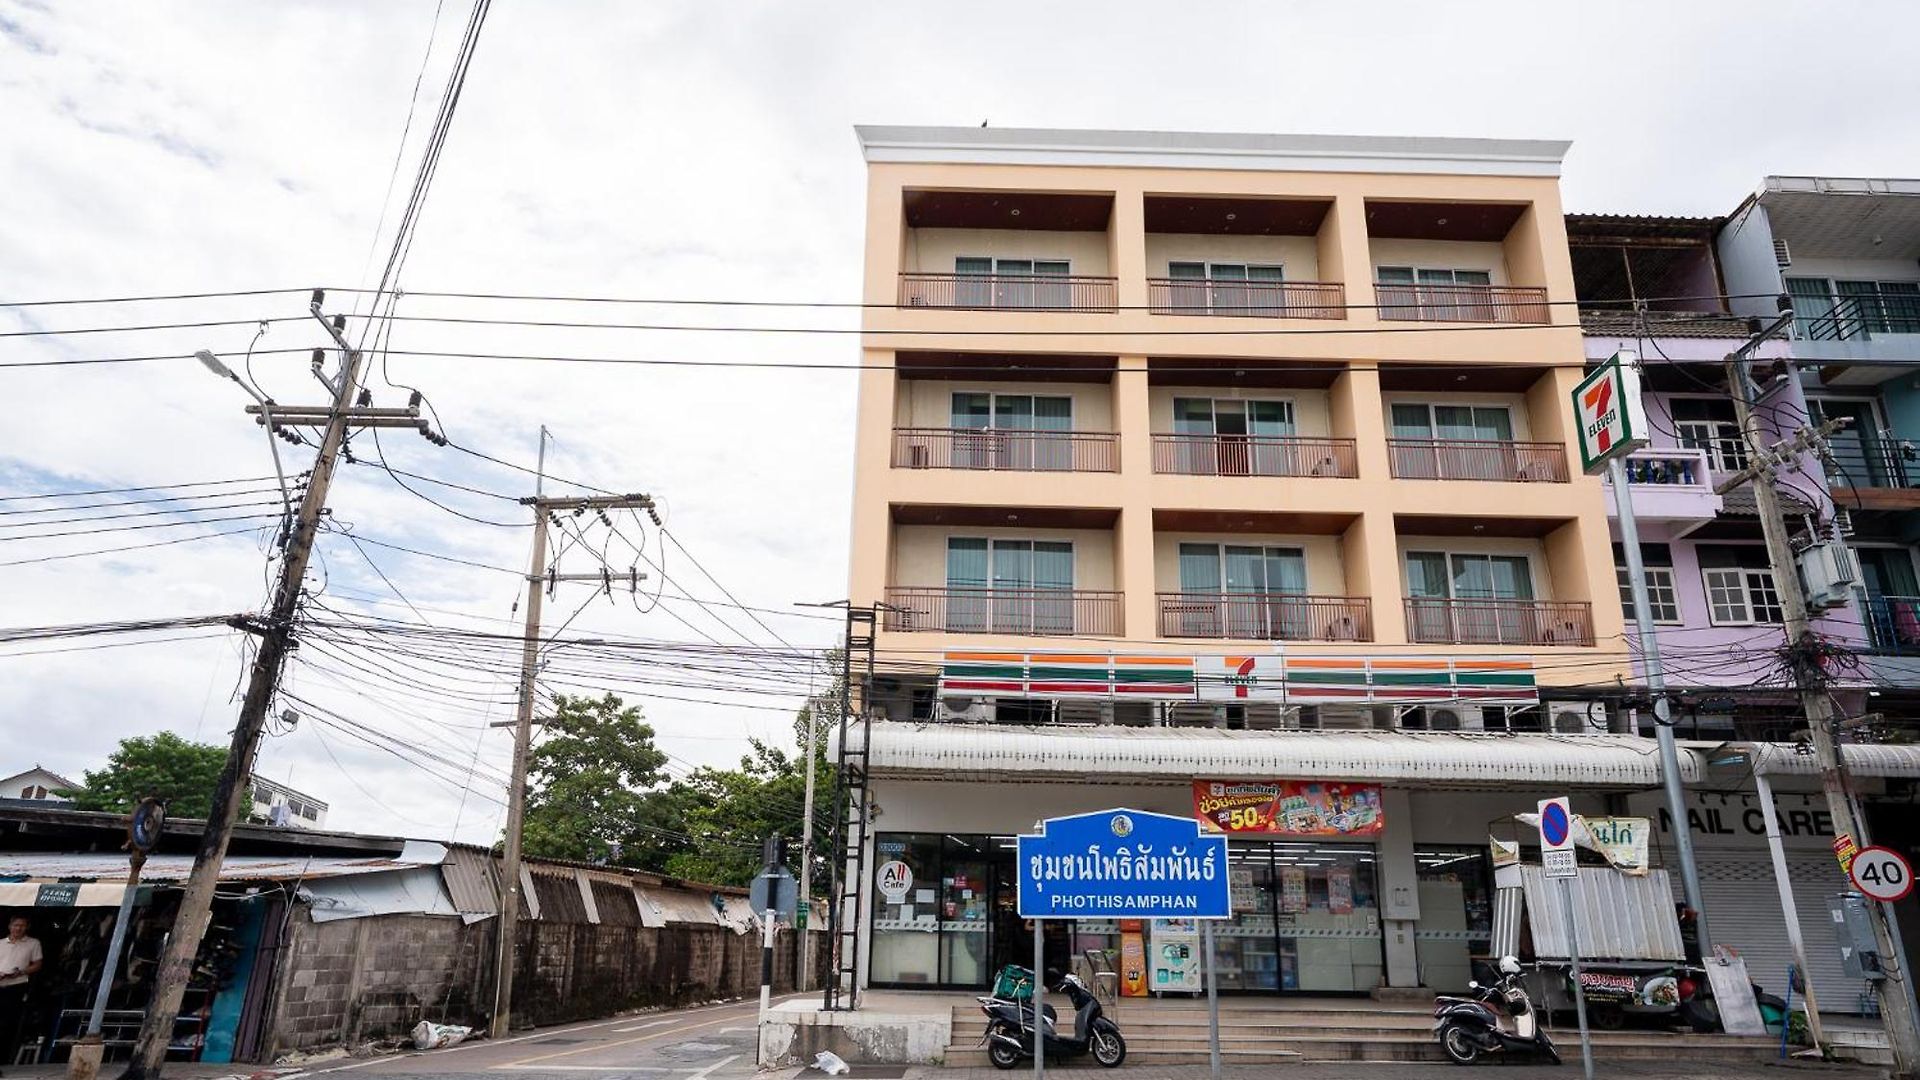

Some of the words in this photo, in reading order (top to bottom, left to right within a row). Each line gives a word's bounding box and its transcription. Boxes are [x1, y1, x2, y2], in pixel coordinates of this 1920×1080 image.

[1584, 376, 1612, 455] 7
[1224, 657, 1255, 698] 7
[1658, 807, 1735, 834] NAIL
[1743, 809, 1836, 836] CARE
[884, 863, 906, 881] All
[1030, 843, 1216, 892] ชุมชนโพธิสัมพันธ์
[1862, 861, 1903, 886] 40
[1051, 895, 1198, 908] PHOTHISAMPHAN
